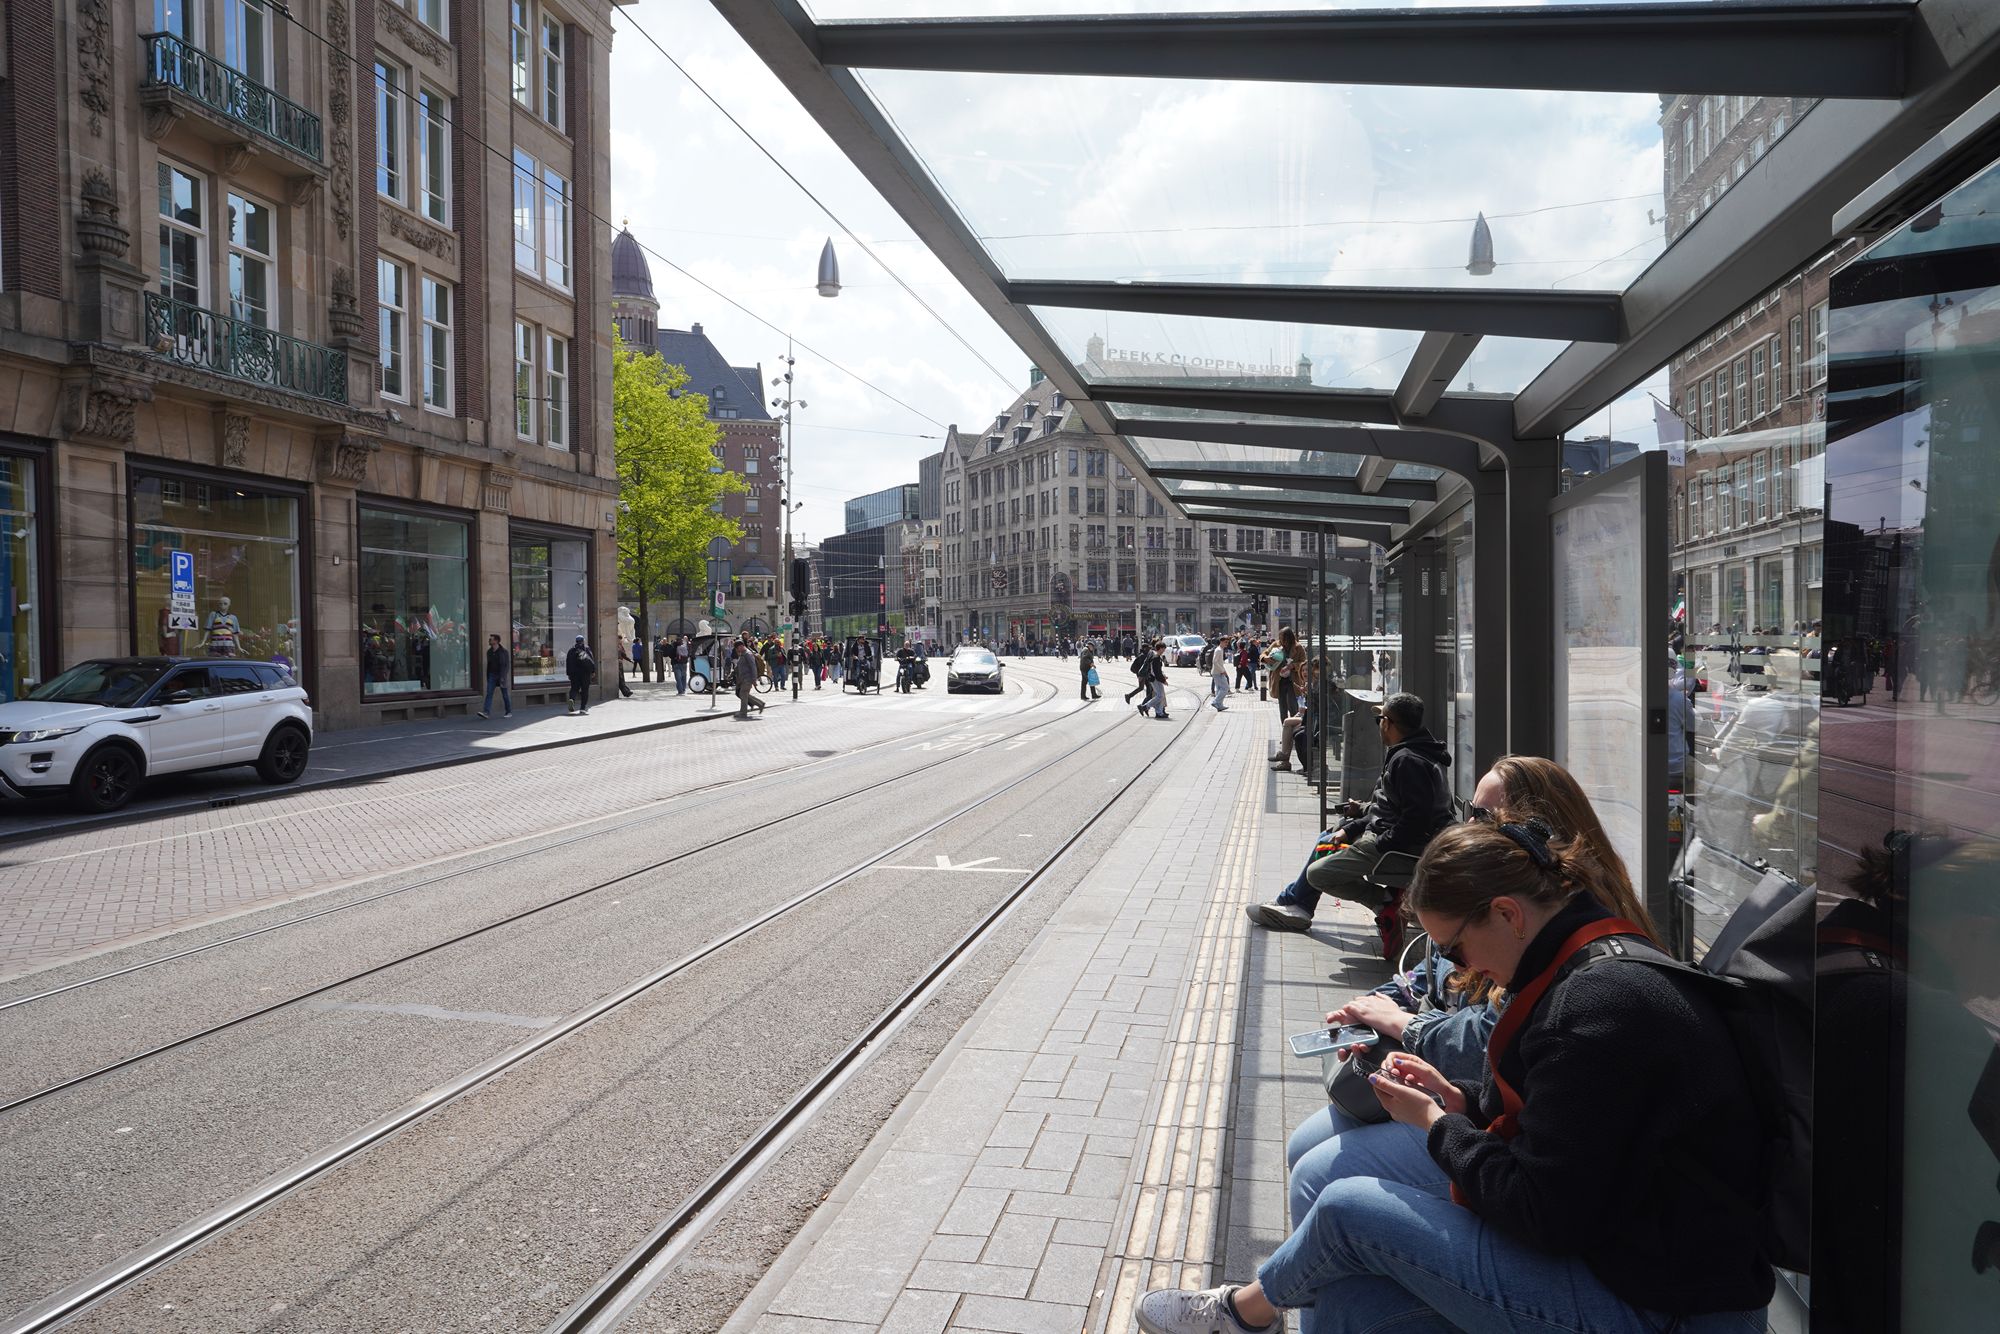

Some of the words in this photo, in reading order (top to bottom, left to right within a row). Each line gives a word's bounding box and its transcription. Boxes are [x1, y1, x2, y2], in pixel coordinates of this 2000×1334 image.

[1107, 348, 1150, 362] PEEK
[1154, 351, 1168, 364] &
[1170, 354, 1293, 375] CLOPPENBURG
[176, 555, 189, 576] P
